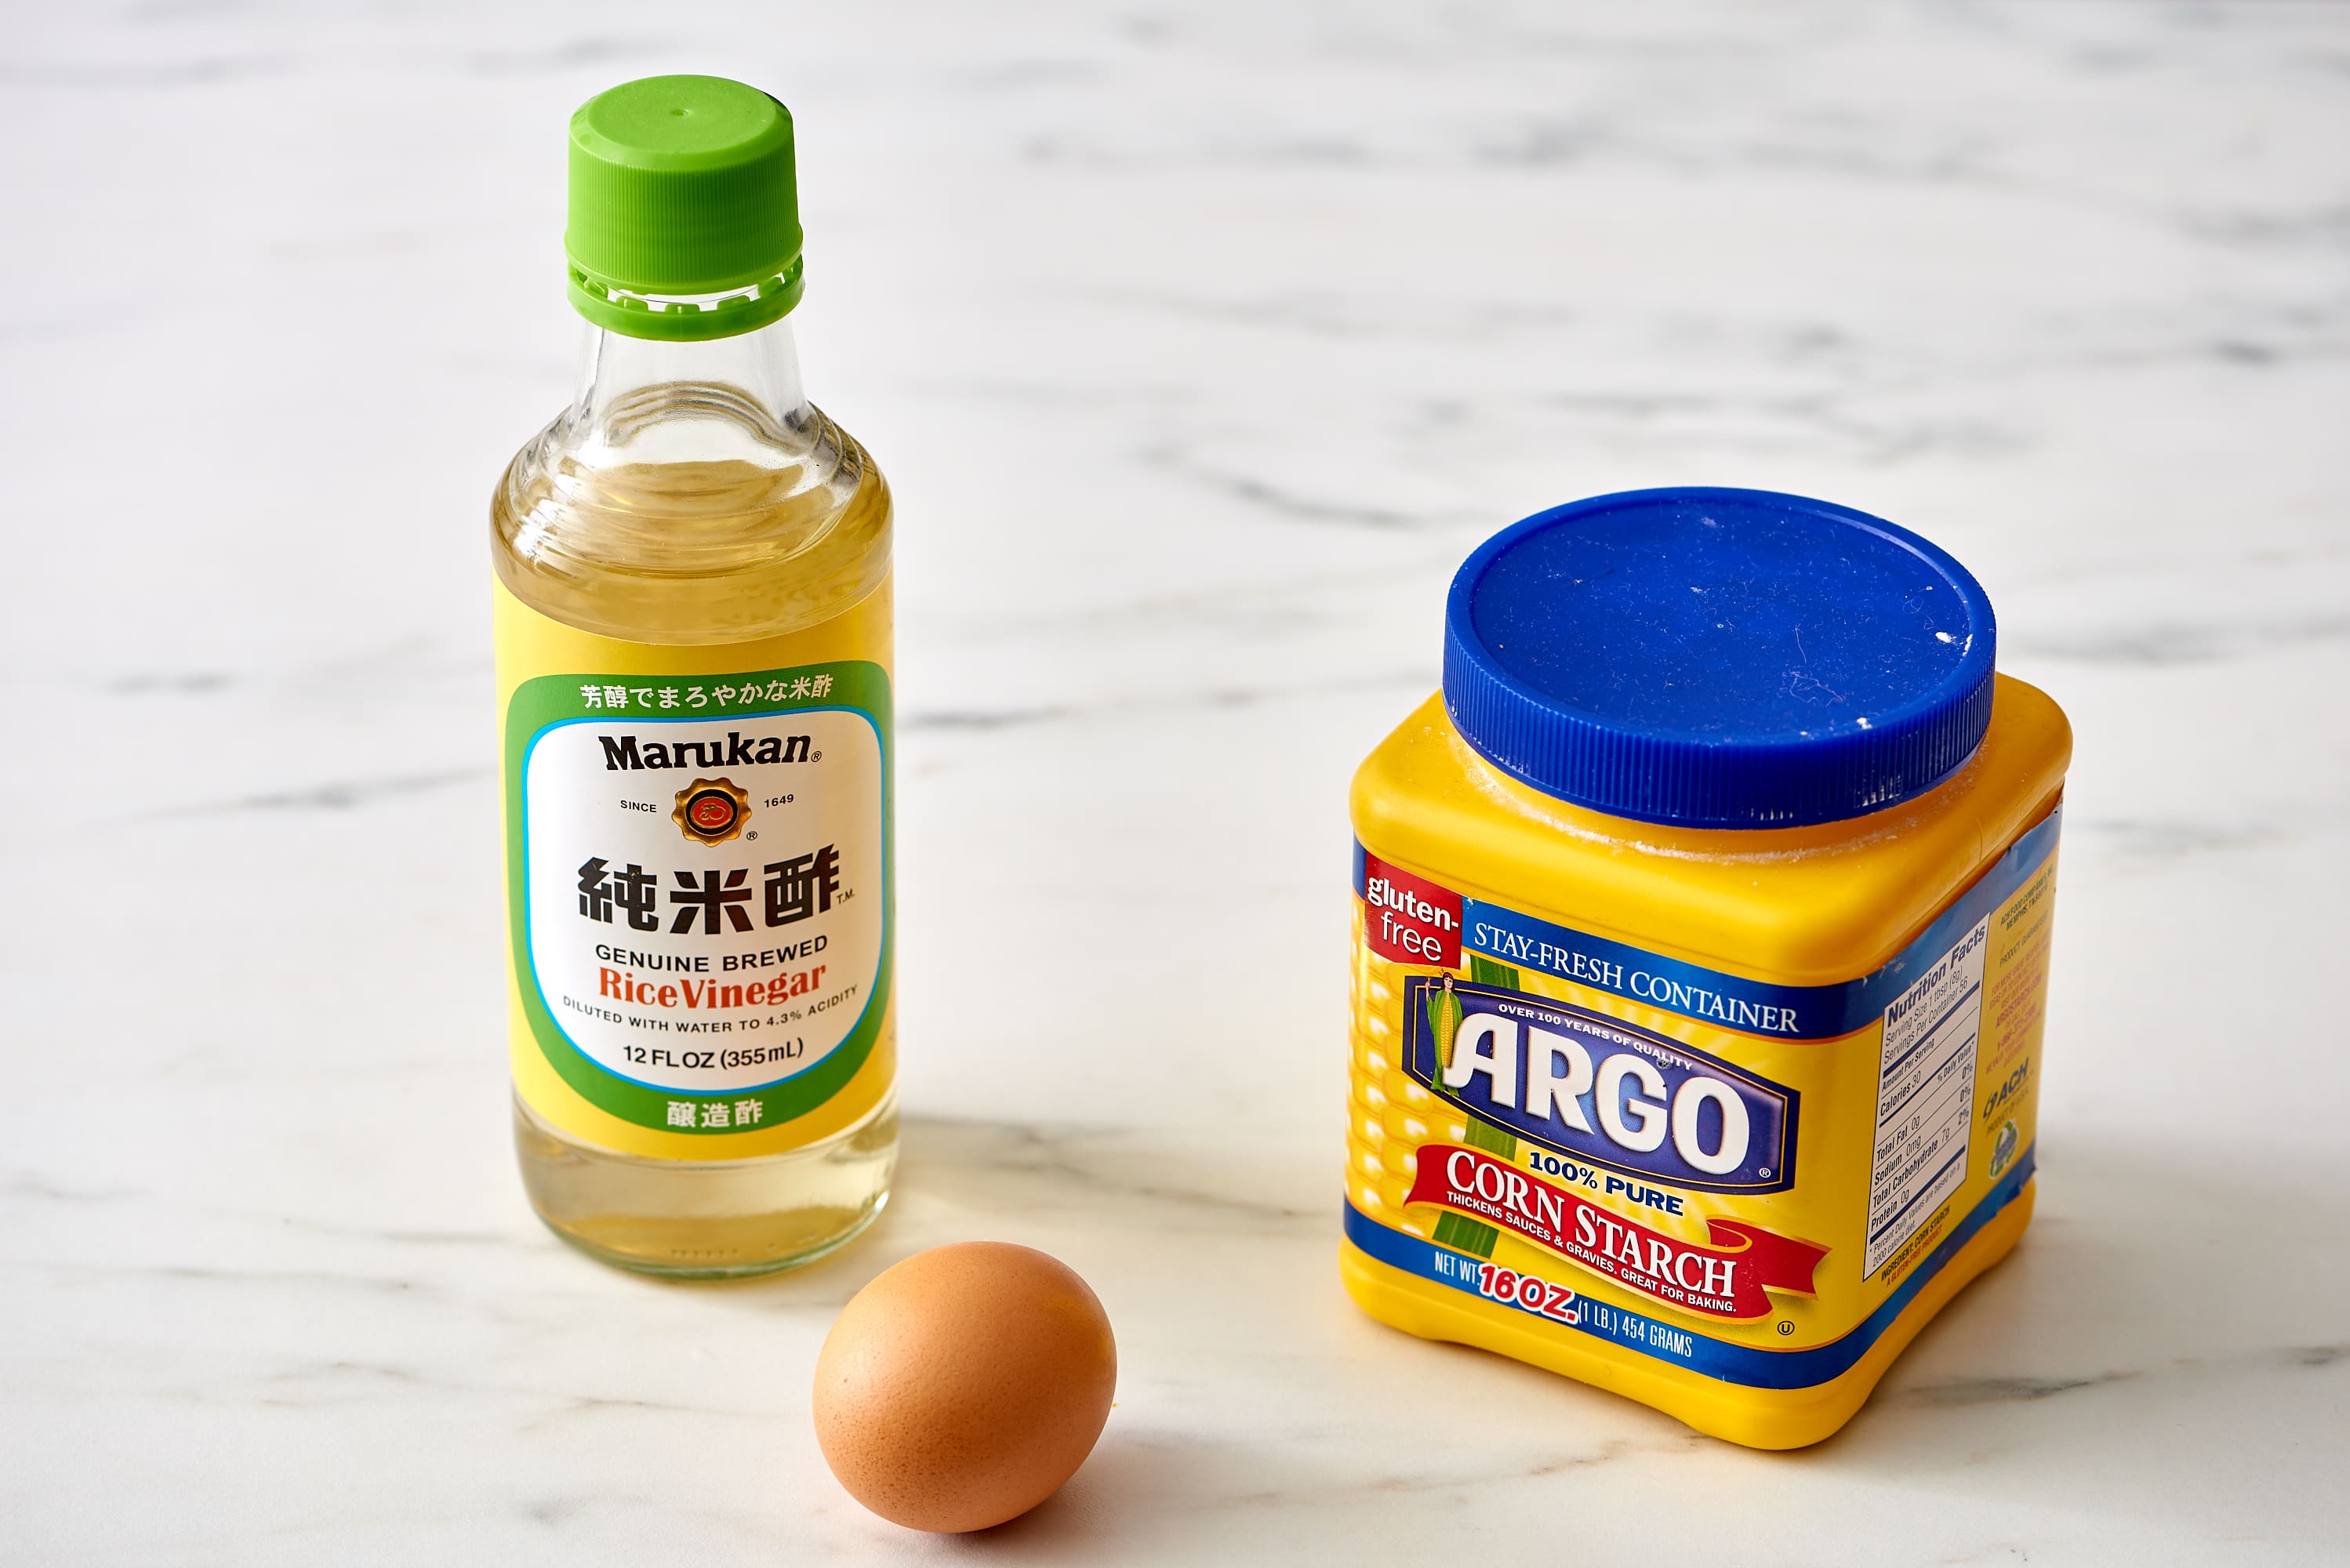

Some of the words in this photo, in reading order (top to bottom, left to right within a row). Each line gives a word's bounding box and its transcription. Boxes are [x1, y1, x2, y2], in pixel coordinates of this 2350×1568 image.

[580, 674, 833, 710] 芳醇でまろやかな米酢
[598, 731, 813, 771] Marukan
[620, 799, 657, 814] SINCE
[764, 793, 794, 808] 1649
[578, 844, 839, 935] 純米酢
[1367, 875, 1459, 932] gluten-
[595, 944, 710, 972] GENUINE
[722, 935, 828, 971] BREWED
[1381, 913, 1442, 961] free
[563, 996, 623, 1025] DILUTED
[629, 1015, 669, 1032] WITH
[676, 1022, 732, 1033] WATER
[739, 1018, 760, 1029] TO
[767, 1010, 801, 1027] 4.3%
[808, 984, 859, 1015] ACIDITY
[1474, 922, 1624, 991] STAY-FRESH
[1629, 972, 1800, 1034] CONTAINER
[1886, 1015, 1912, 1046] Serving
[1914, 1003, 1927, 1022] Size
[1929, 994, 1932, 1006] 1
[1934, 981, 1947, 1000] tbsp
[1949, 966, 1962, 988] (8g)
[1887, 960, 1946, 1028] Nutrition
[1951, 924, 1985, 968] Facts
[1498, 1004, 1535, 1018] OVER
[1538, 1012, 1561, 1025] 100
[1564, 1019, 1610, 1040] YEARS
[1613, 1034, 1631, 1046] OF
[1633, 1041, 1693, 1071] QUALITY
[1884, 1031, 1914, 1065] Servings
[1916, 1018, 1927, 1035] Per
[1928, 988, 1957, 1023] Container
[1959, 975, 1967, 993] 56
[623, 1046, 646, 1064] 12
[1882, 1066, 1903, 1092] Amount
[1904, 1058, 1913, 1073] Per
[1915, 1038, 1934, 1062] Serving
[1944, 1058, 1956, 1077] Daily
[1443, 1012, 1750, 1175] ARGO
[1876, 1138, 1894, 1163] Total
[1897, 1125, 1907, 1144] Fat
[1911, 1115, 1920, 1131] 0g
[1962, 1060, 1972, 1079] 0%
[1880, 1083, 1909, 1116] Calories
[1912, 1070, 1920, 1088] 30
[1872, 1183, 1890, 1208] Total
[1893, 1138, 1938, 1190] Carbohydrate
[1941, 1127, 1949, 1142] 7g
[1875, 1152, 1901, 1185] Sodium
[1906, 1136, 1920, 1156] 0mg
[1960, 1083, 1970, 1102] 0%
[1529, 1152, 1598, 1190] 100%
[1605, 1176, 1684, 1217] PURE
[1871, 1200, 1896, 1231] Protein
[1900, 1188, 1909, 1203] 0g
[1874, 1230, 1893, 1253] Percent
[1895, 1214, 1907, 1233] Daily
[1909, 1199, 1923, 1219] Values
[1934, 1173, 1948, 1192] based
[1446, 1151, 1565, 1233] CORN
[1575, 1208, 1737, 1298] STARCH
[1447, 1191, 1502, 1218] THICKENS
[1505, 1213, 1551, 1239] SAUCES
[1554, 1236, 1564, 1247] &
[1567, 1243, 1618, 1275] GRAVIES.
[1622, 1269, 1658, 1291] GREAT
[1662, 1285, 1684, 1301] FOR
[1687, 1294, 1737, 1312] BAKING.
[1872, 1247, 1886, 1267] 2000
[1888, 1231, 1904, 1252] calorie
[1881, 1243, 1912, 1281] INGREDIENT:
[1914, 1226, 1928, 1247] CORN
[1930, 1205, 1949, 1232] STARCH
[1434, 1251, 1455, 1276] NET
[1578, 1301, 1589, 1323] (1
[1595, 1305, 1618, 1335] LB.)
[1622, 1316, 1645, 1341] 454
[1650, 1325, 1692, 1358] GRAMS
